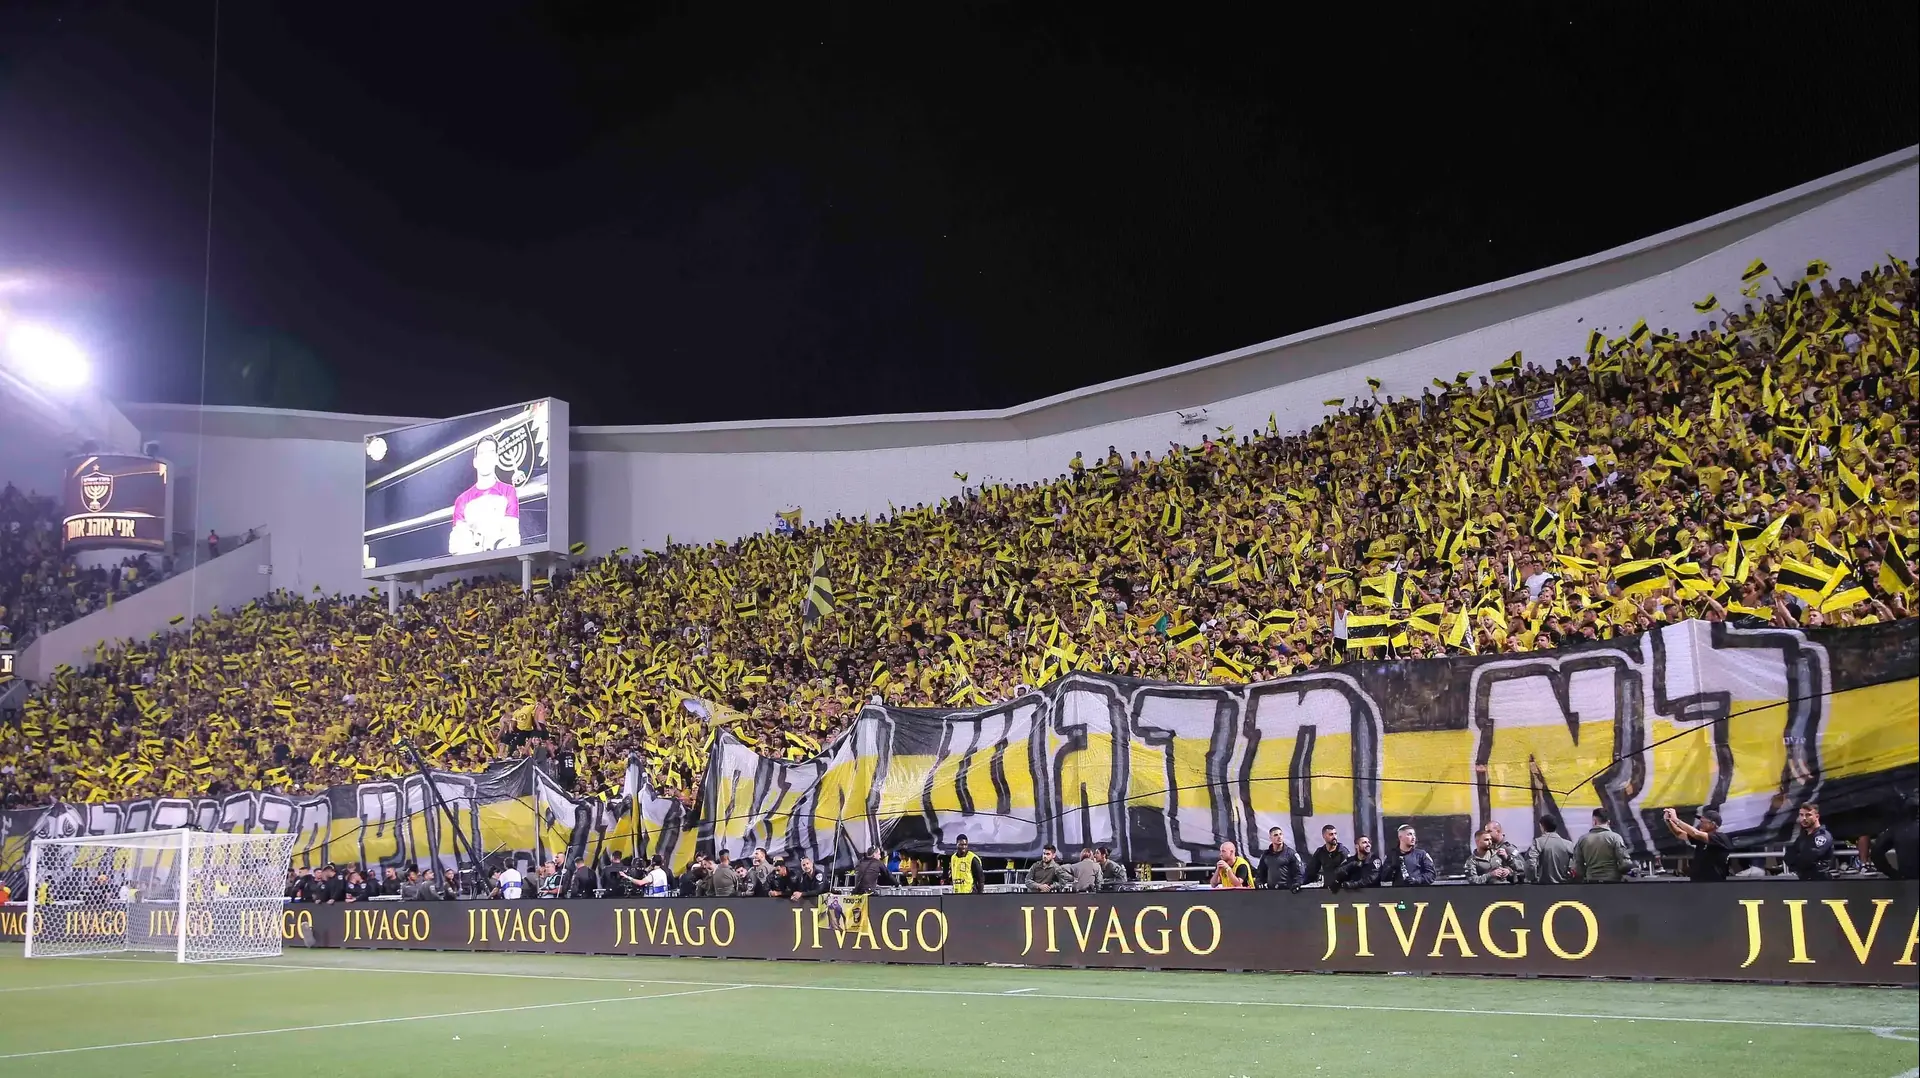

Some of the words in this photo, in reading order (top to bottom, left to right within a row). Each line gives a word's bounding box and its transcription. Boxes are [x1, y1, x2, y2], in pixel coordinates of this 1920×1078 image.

[115, 518, 135, 538] אני
[564, 759, 574, 768] 15
[66, 911, 127, 936] JIVAGO
[343, 909, 430, 942] JIVAGO
[467, 908, 570, 945] JIVAGO
[614, 908, 735, 948] JIVAGO
[1020, 905, 1222, 956] JIVAGO
[1320, 900, 1599, 960] JIVAGO
